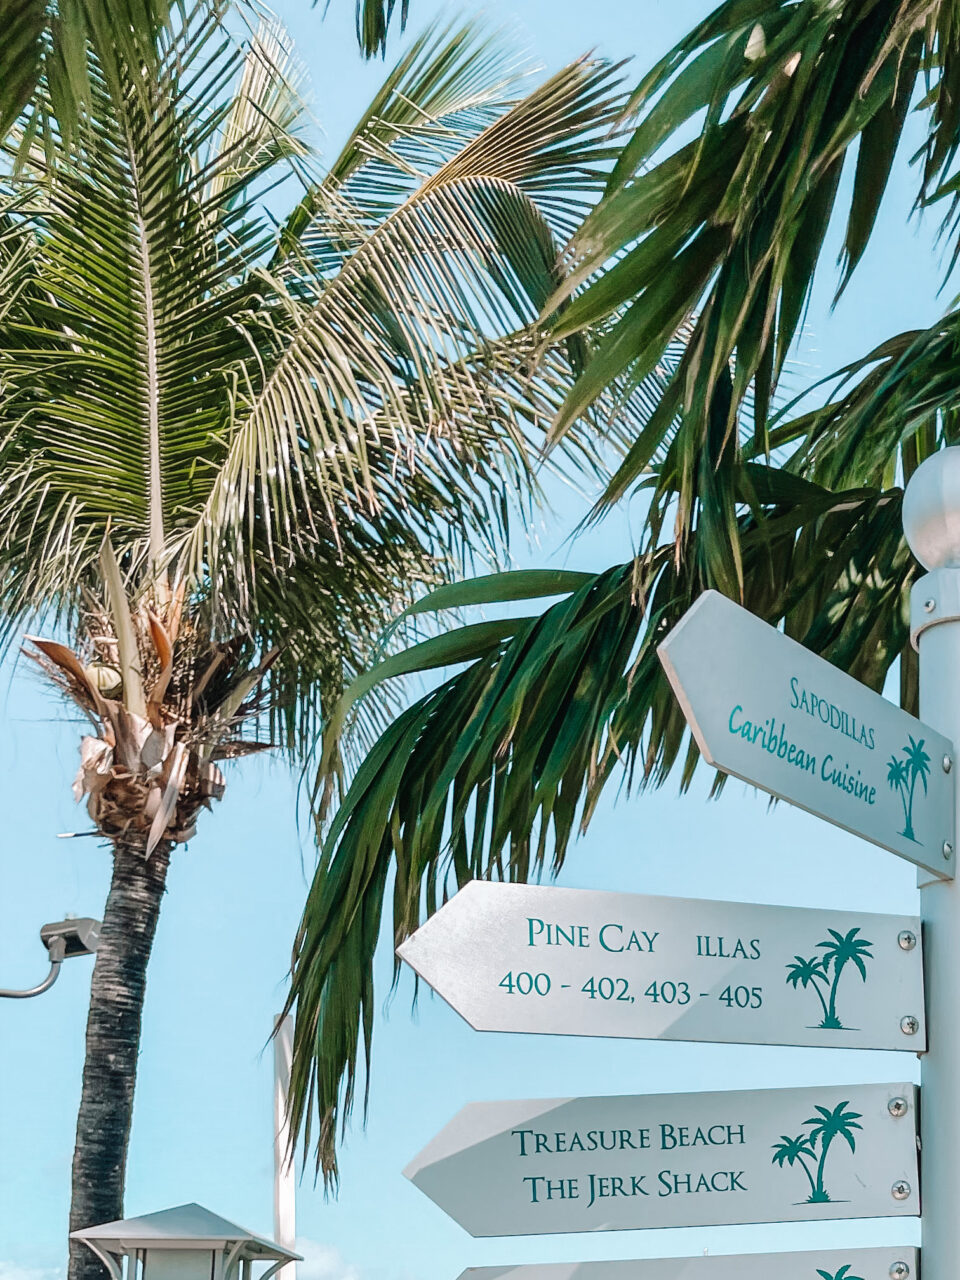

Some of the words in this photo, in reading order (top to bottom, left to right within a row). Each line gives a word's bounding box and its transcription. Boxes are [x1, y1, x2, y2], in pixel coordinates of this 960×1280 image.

[788, 676, 876, 751] SAPODILLAS
[727, 704, 818, 776] Caribbean
[820, 754, 877, 805] Cuisine
[526, 917, 590, 948] PINE
[598, 923, 660, 953] CAY
[498, 971, 552, 997] 400
[581, 976, 635, 1004] 402,
[644, 980, 691, 1006] 403
[718, 985, 763, 1009] 405
[511, 1128, 651, 1157] TREASURE
[658, 1123, 746, 1150] BEACH
[522, 1176, 580, 1203] THE
[587, 1174, 650, 1208] JERK
[657, 1169, 748, 1198] SHACK
